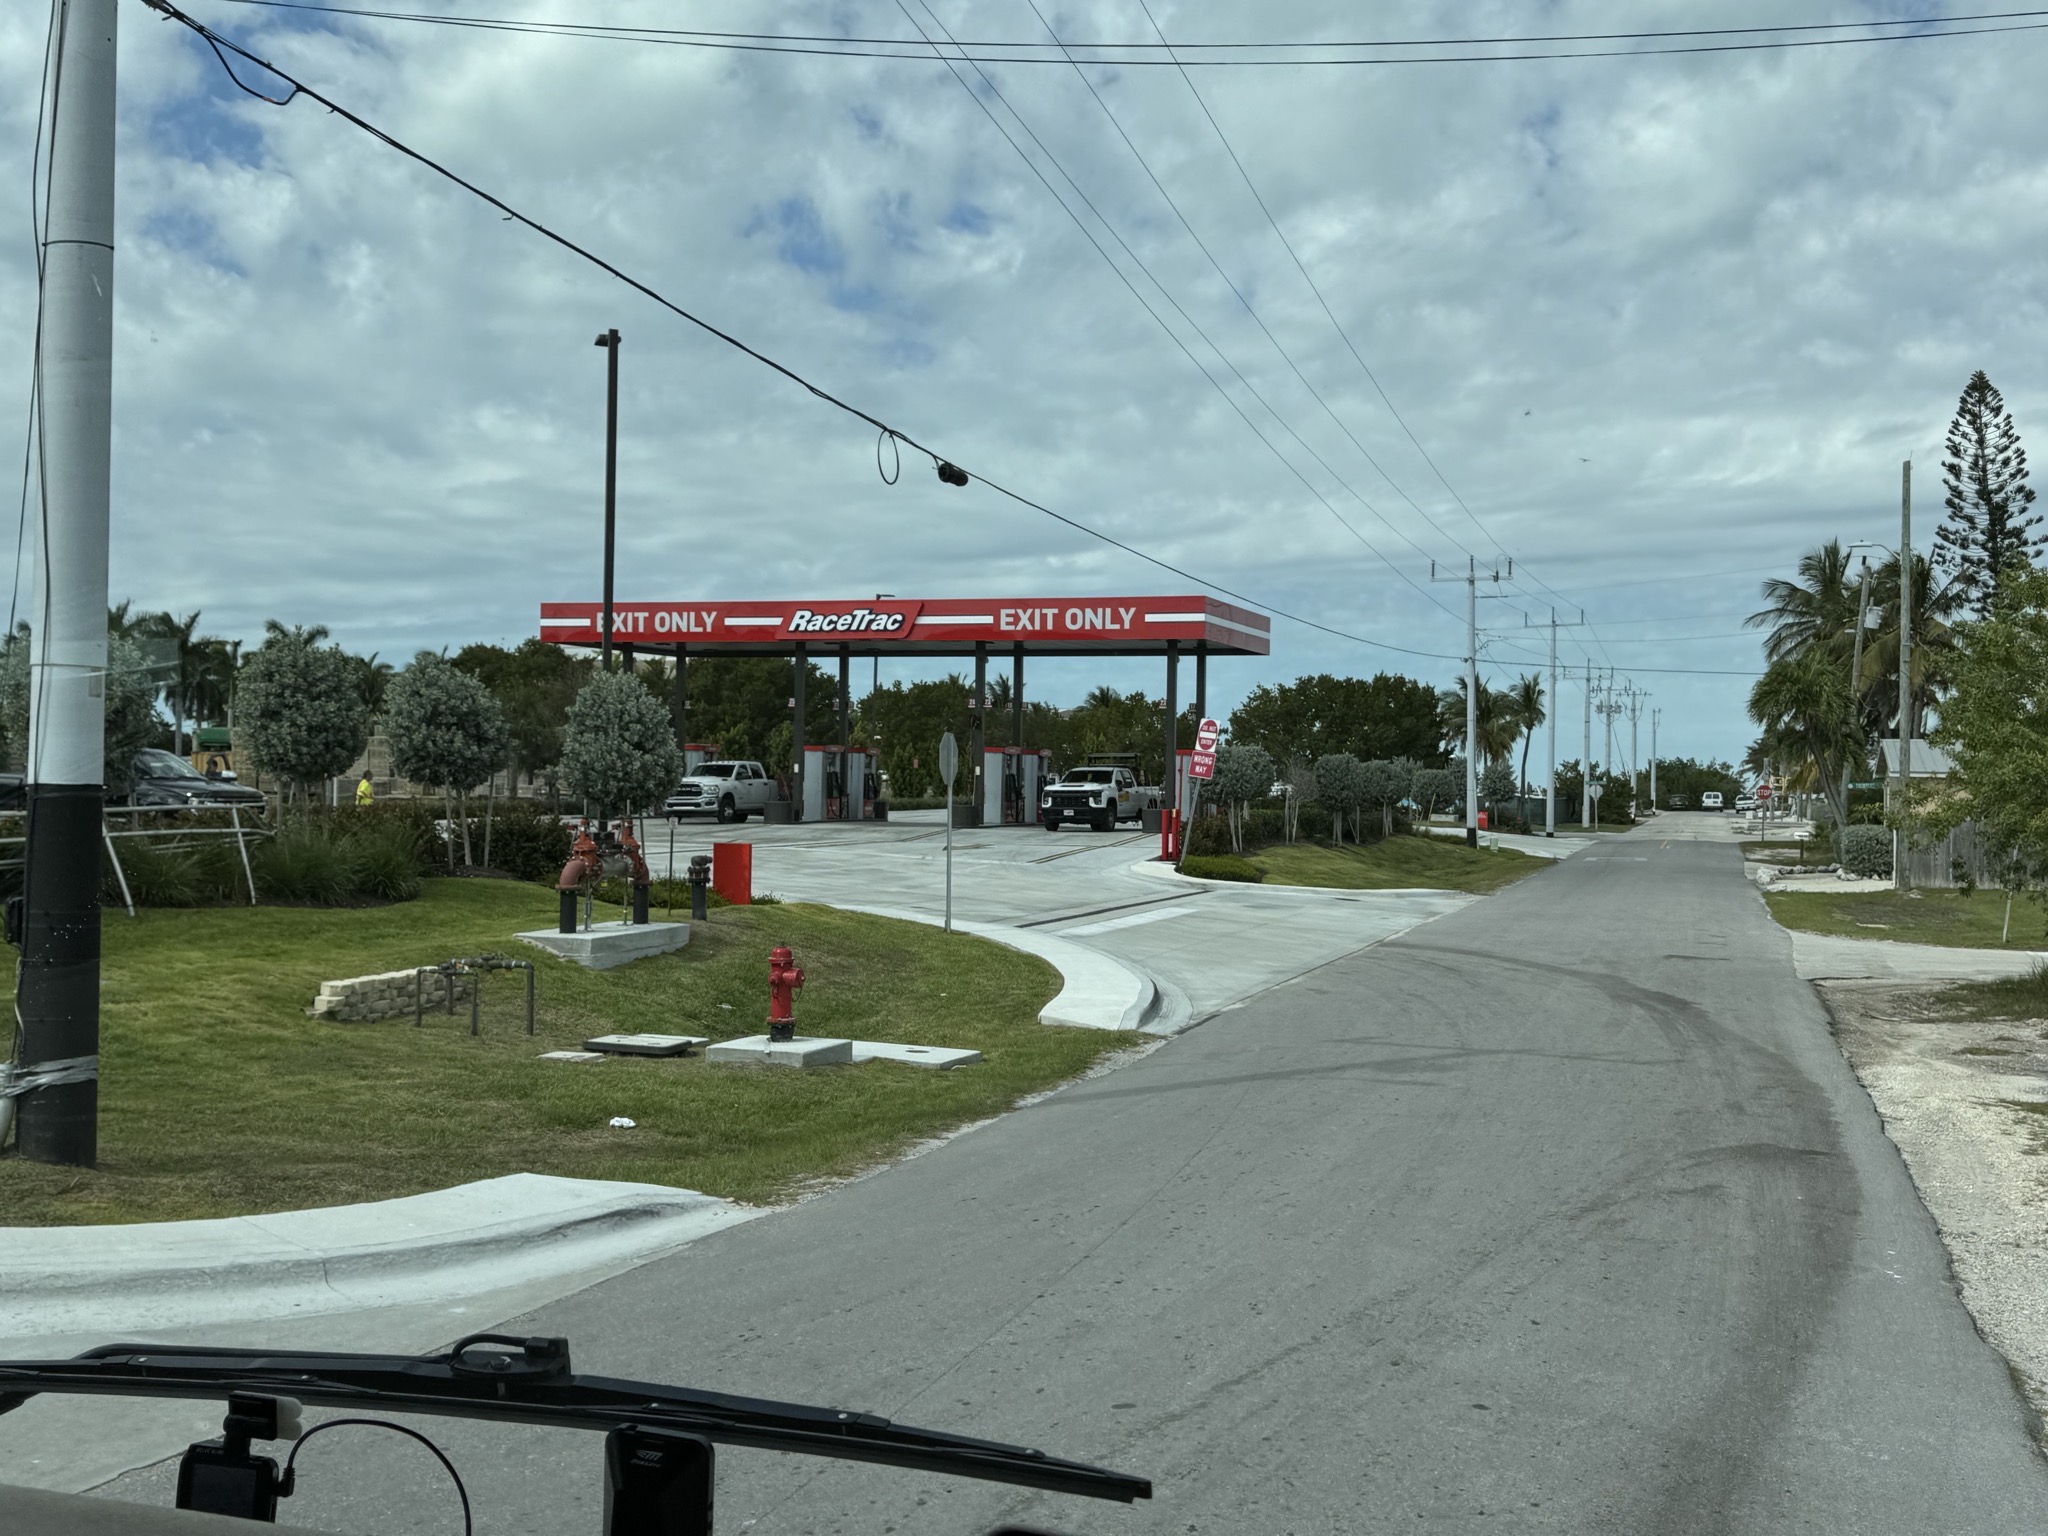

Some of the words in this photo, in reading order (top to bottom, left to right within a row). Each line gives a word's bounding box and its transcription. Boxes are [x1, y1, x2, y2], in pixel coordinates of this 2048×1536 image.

[596, 612, 649, 633] EXIT
[654, 611, 718, 633] ONLY
[787, 609, 905, 633] RaceTrac
[999, 608, 1058, 631] EXIT
[1065, 607, 1137, 630] ONLY
[1194, 755, 1213, 766] WRONG
[1194, 765, 1208, 774] WAY
